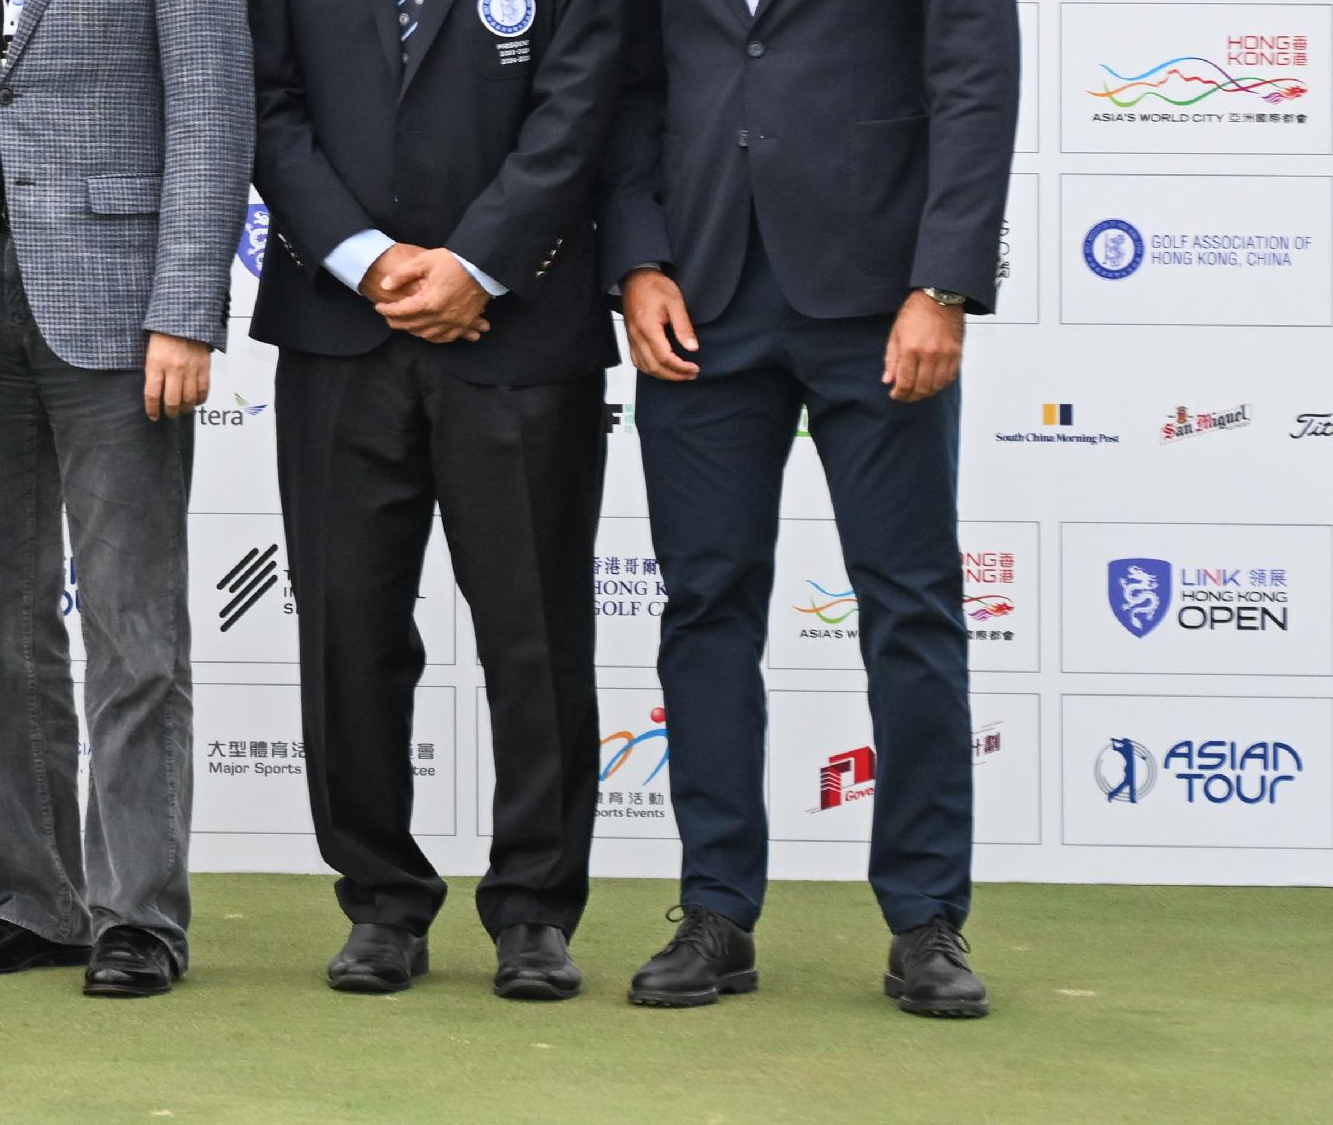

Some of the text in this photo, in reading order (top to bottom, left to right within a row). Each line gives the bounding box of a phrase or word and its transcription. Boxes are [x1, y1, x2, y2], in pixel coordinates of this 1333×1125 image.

[1228, 36, 1307, 50] HONG 香
[1228, 52, 1307, 66] KONG 港
[1093, 113, 1308, 124] ASIA'S WORLD CITY 亞洲國際都會
[1152, 235, 1312, 250] GOLF ASSOCIATION OF
[1152, 251, 1291, 266] HONG KONG, CHINA
[1161, 404, 1250, 441] San Miguel
[996, 433, 1119, 446] South China Morning Post
[1182, 569, 1287, 587] LINK 領展
[1181, 590, 1288, 602] HONG KONG
[1178, 606, 1288, 631] OPEN
[800, 629, 843, 639] ASIA'S
[1163, 741, 1303, 772] ASIAN
[209, 762, 302, 777] Major Sports
[1175, 774, 1295, 805] TOUR
[626, 808, 665, 818] Events
